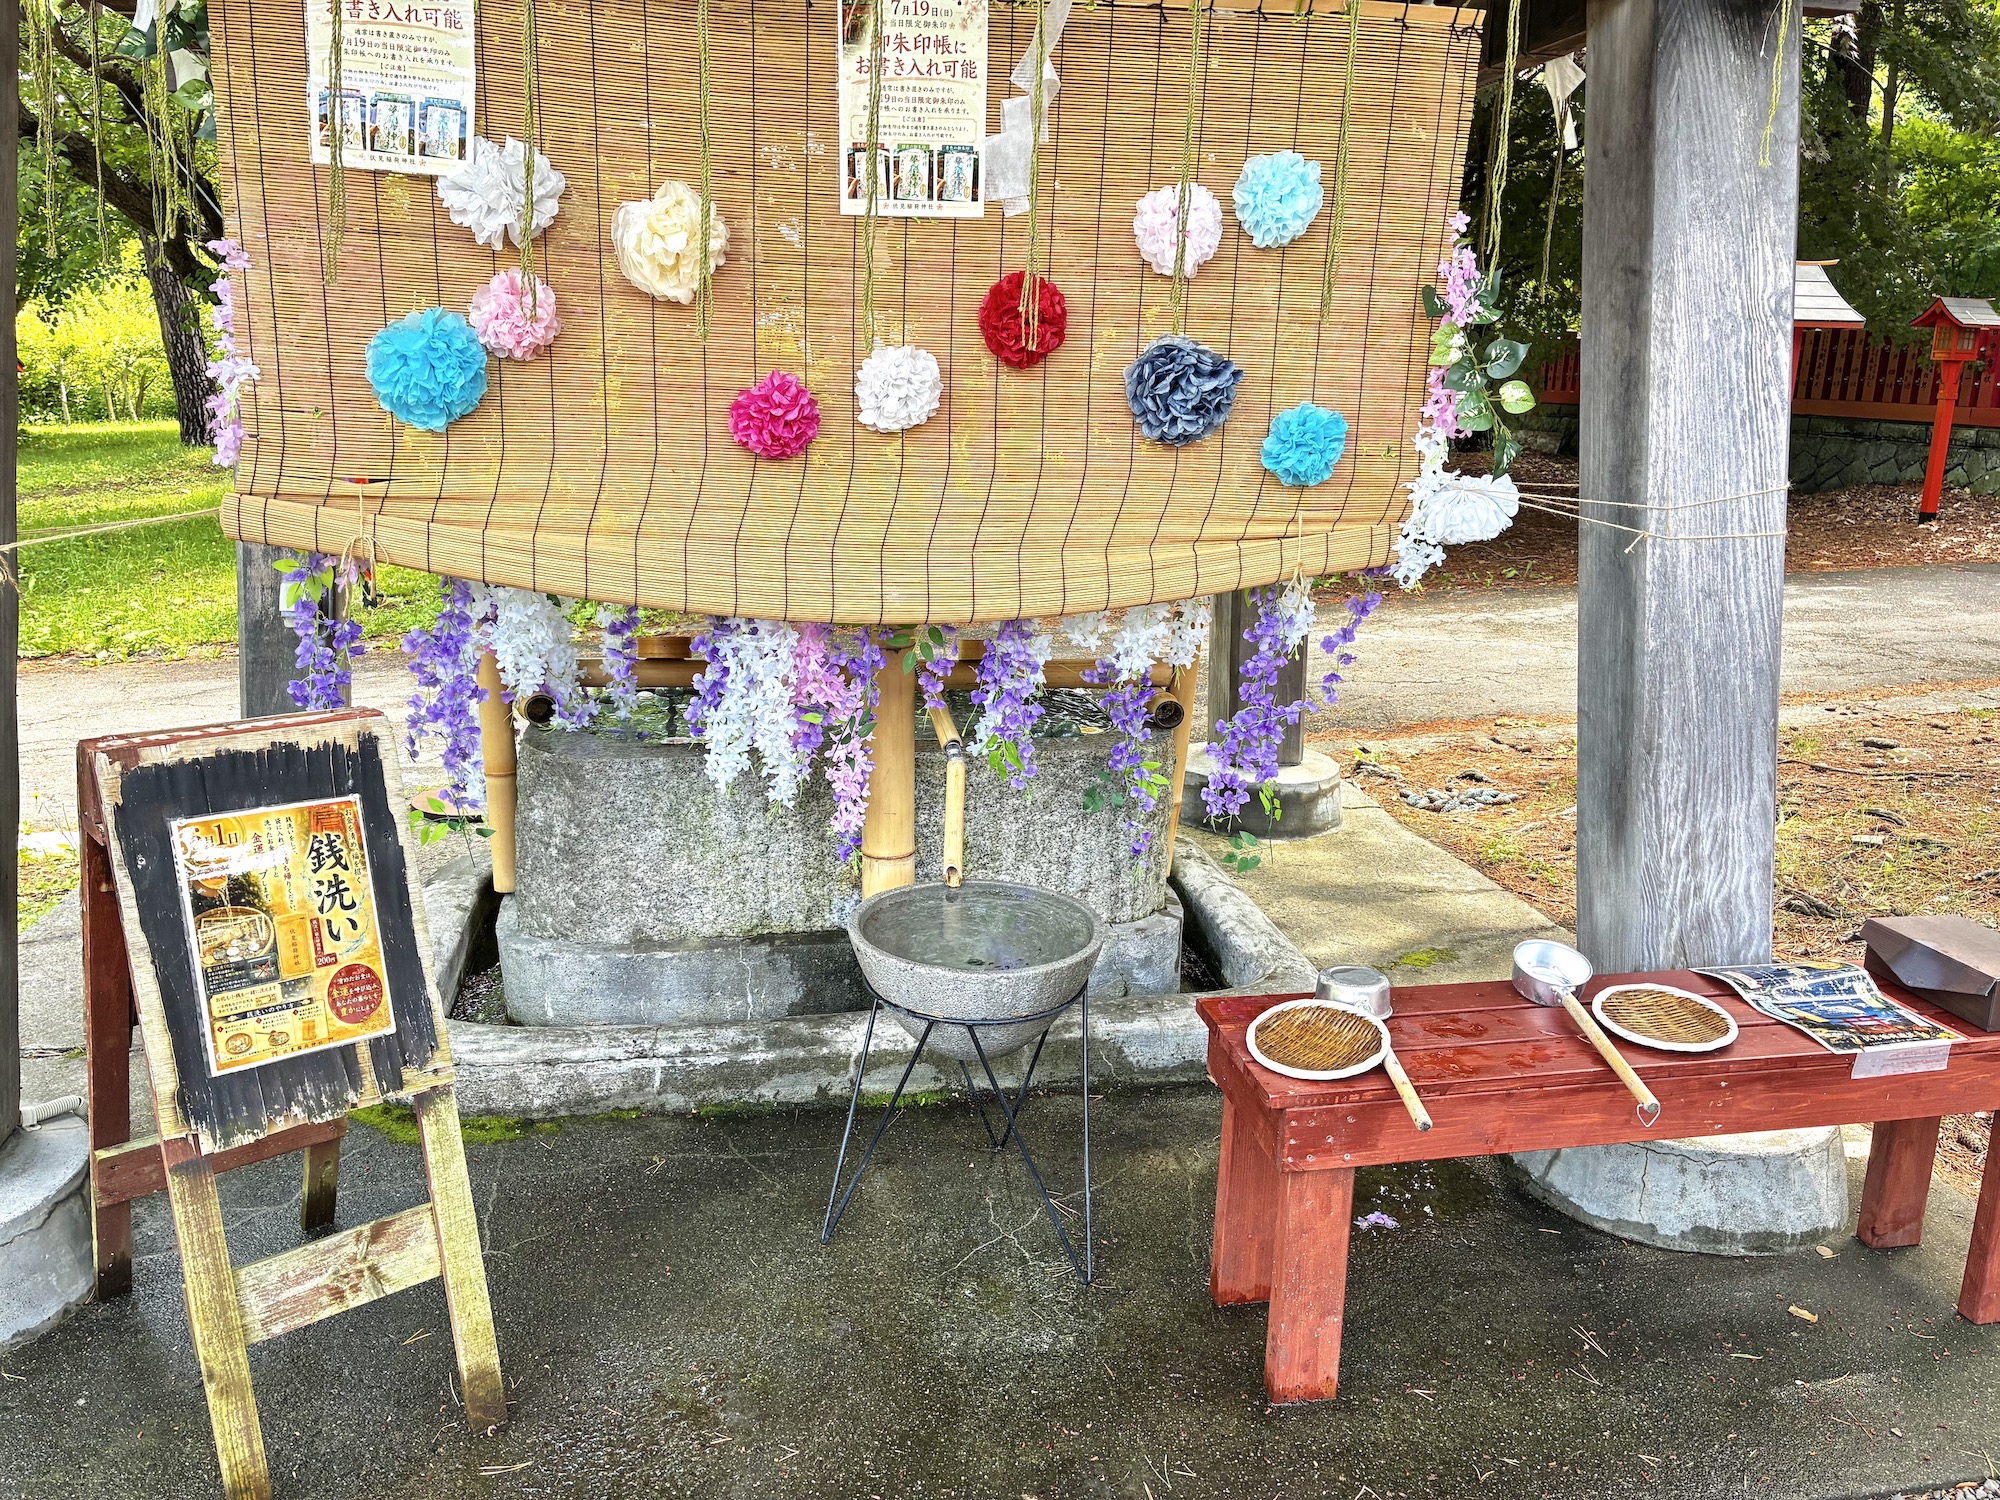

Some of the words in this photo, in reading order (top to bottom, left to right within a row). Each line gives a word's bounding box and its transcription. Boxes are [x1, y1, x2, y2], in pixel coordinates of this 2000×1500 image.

[890, 19, 947, 29] 当日限定御朱印
[354, 28, 438, 44] 通常は書き置きのみですが、
[342, 48, 456, 67] 朱印帳へのお書き入れを承ります。
[862, 105, 970, 115] 御帳へのお書き入れを承ります。
[369, 154, 416, 166] 伏見稲荷神社
[345, 809, 362, 884] お金を清め、福を招く
[306, 833, 358, 941] 銭洗い
